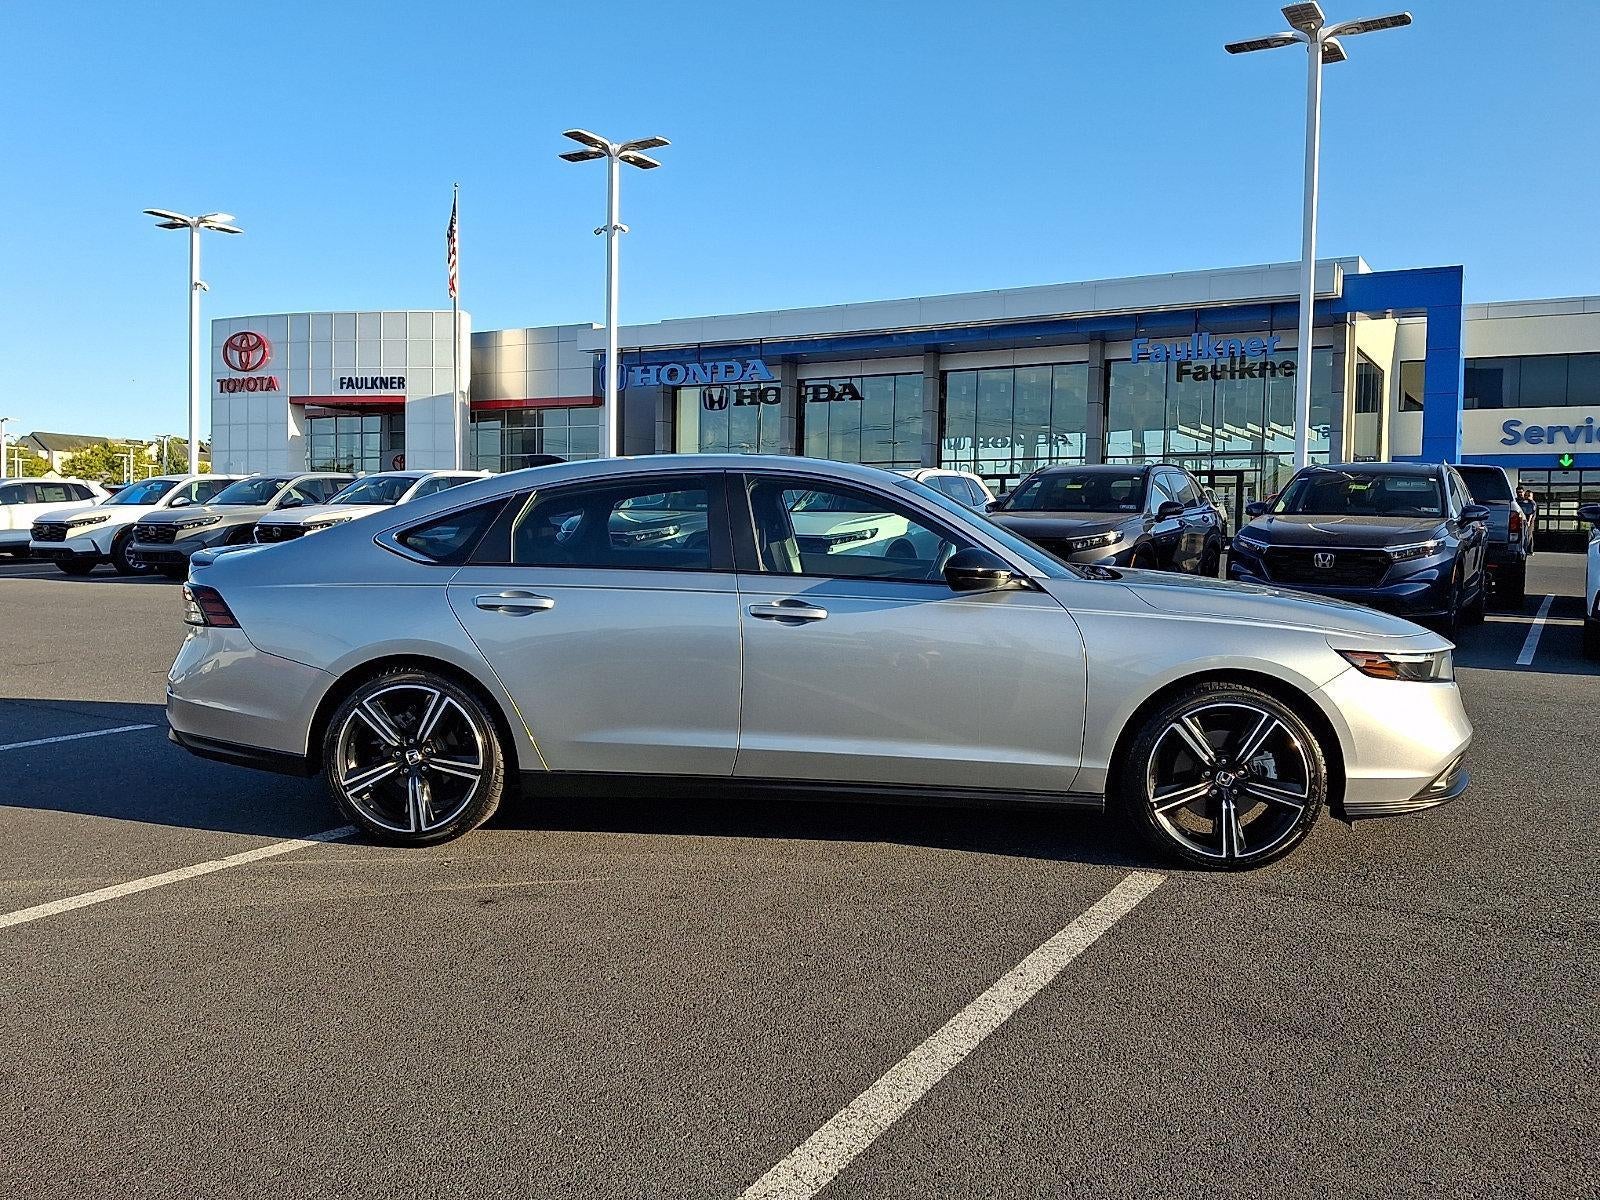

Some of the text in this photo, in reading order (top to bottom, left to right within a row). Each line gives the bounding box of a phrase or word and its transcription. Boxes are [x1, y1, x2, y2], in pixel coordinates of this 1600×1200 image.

[1131, 332, 1281, 364] Faulkner
[632, 359, 774, 386] HONDA
[1176, 355, 1298, 382] Faulkne
[216, 376, 279, 393] TOYOTA
[339, 376, 406, 390] FAULKNER
[732, 383, 866, 406] HODA
[1500, 417, 1600, 446] Servi
